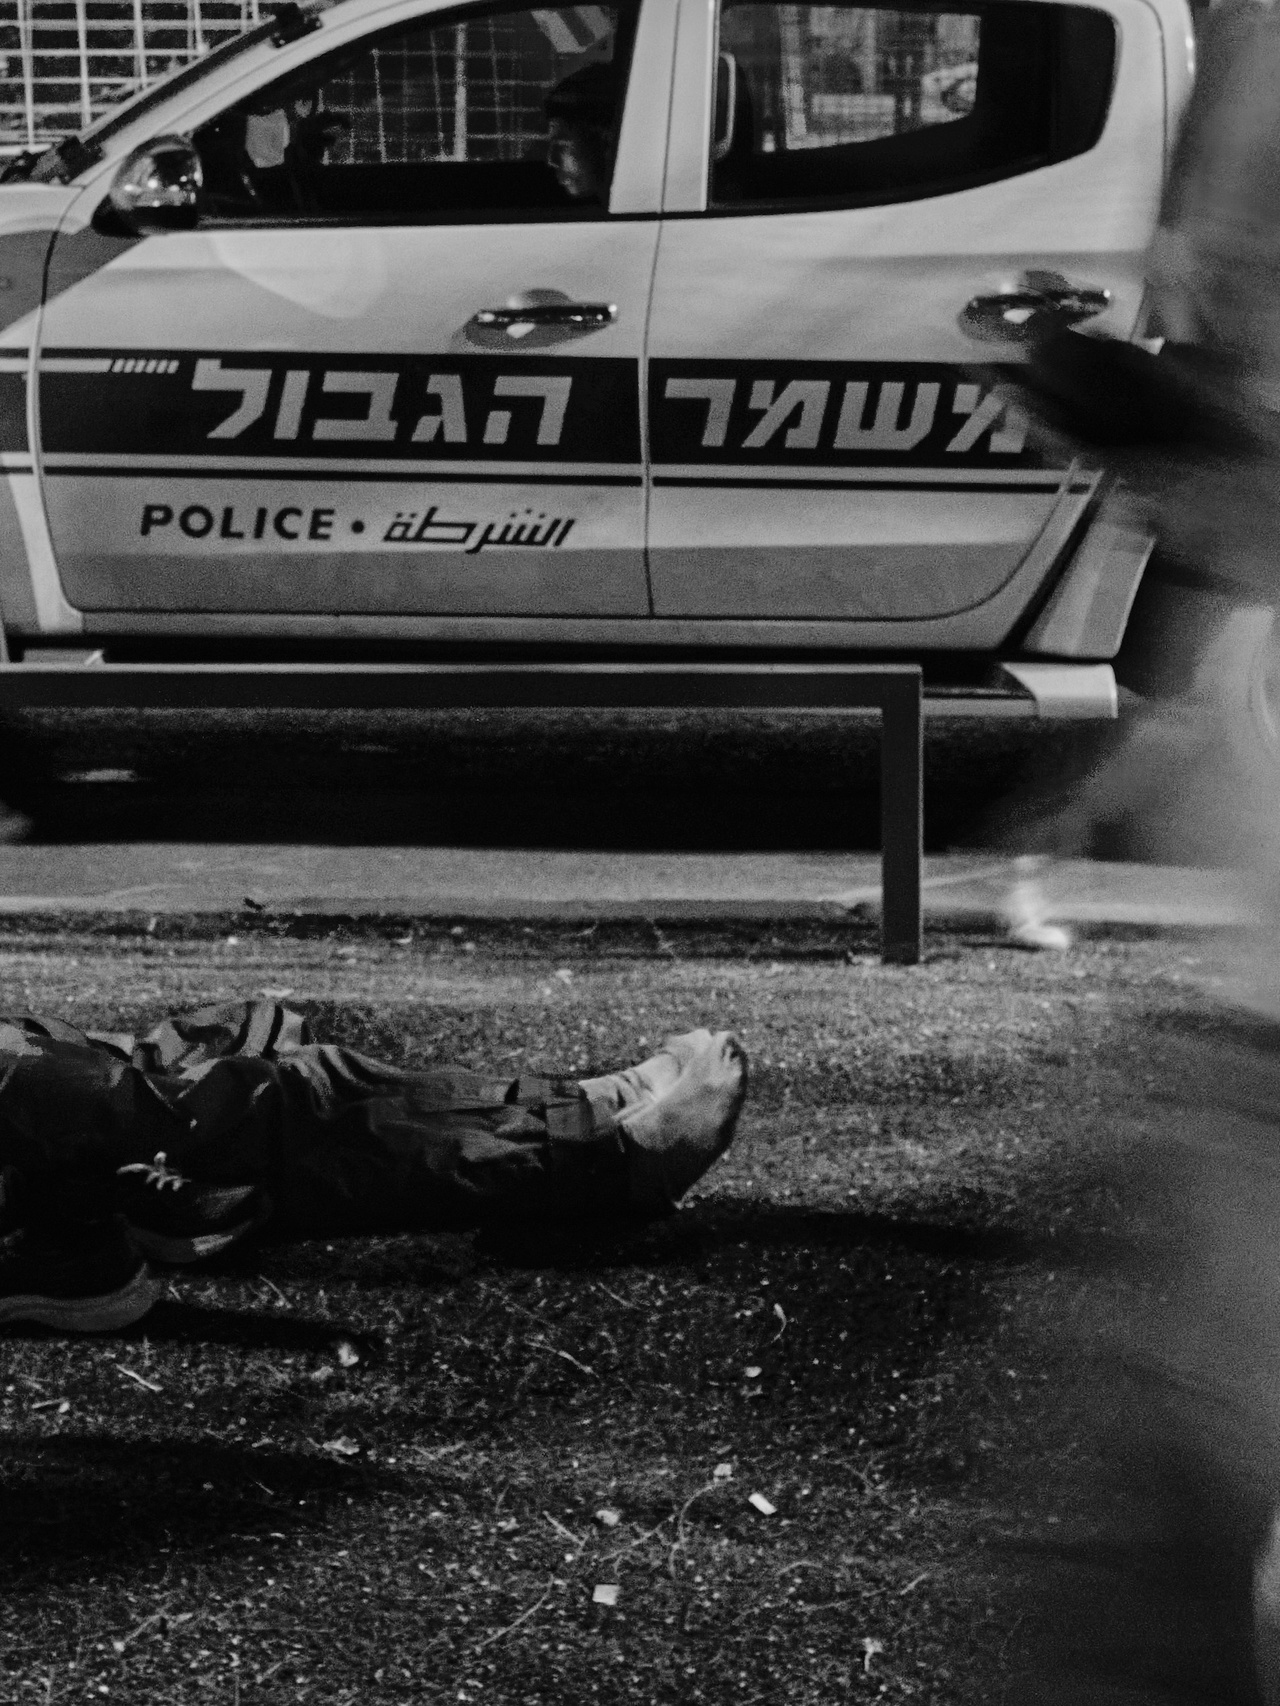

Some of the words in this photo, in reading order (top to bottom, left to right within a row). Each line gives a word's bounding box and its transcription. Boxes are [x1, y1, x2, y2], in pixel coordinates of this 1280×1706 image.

[191, 358, 573, 446] הגבול
[664, 377, 1029, 454] משמר
[139, 503, 337, 542] POLICE
[382, 506, 577, 554] الشرطة
